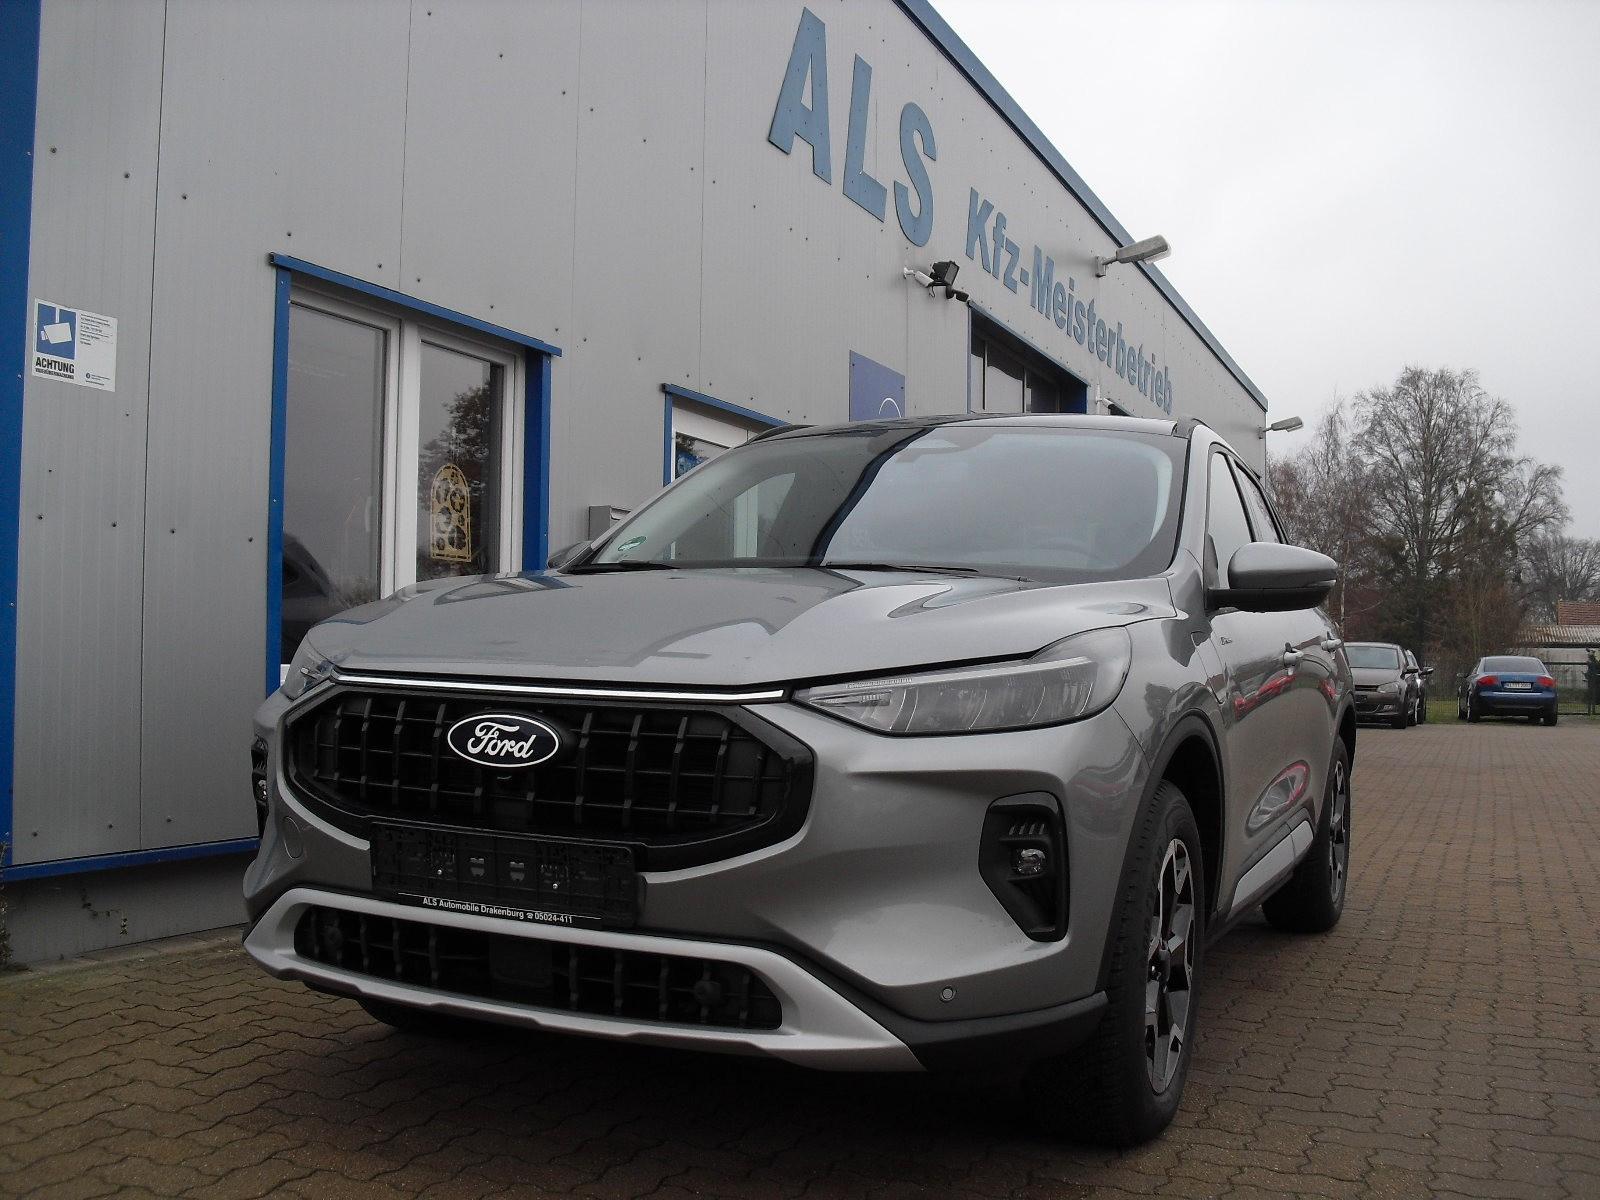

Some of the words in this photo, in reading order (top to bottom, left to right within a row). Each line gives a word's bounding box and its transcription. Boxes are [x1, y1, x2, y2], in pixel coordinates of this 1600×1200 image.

[768, 7, 937, 247] ALS
[966, 187, 1173, 415] Kfz-Meisterbetrieb
[36, 357, 75, 374] ACHTUNG
[467, 721, 537, 759] Ford
[422, 897, 437, 907] ALS
[439, 899, 480, 912] Automobile
[481, 905, 524, 920] Drakenburg
[534, 911, 573, 924] 05024-411
